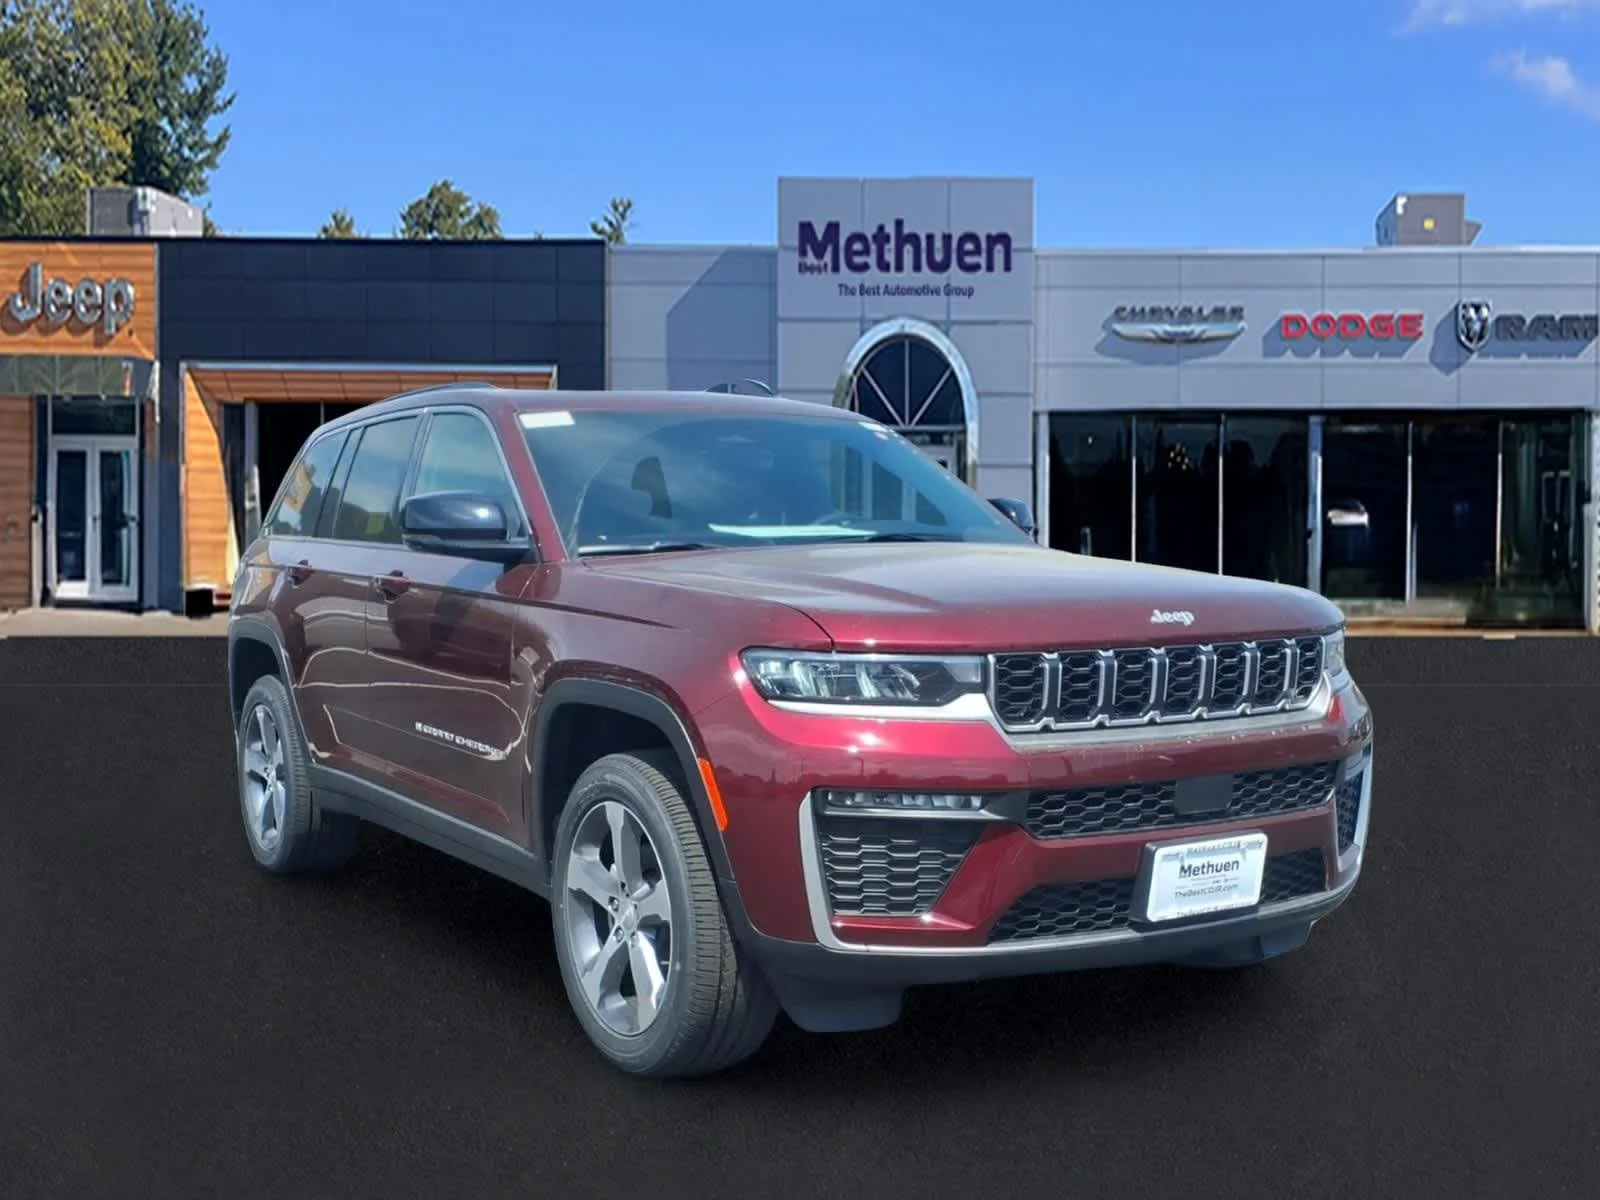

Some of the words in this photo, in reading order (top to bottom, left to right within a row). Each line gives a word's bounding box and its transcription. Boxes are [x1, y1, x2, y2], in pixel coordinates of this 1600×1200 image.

[798, 217, 1012, 274] Methuen
[9, 262, 134, 336] Jeep
[838, 283, 857, 297] The
[859, 283, 880, 297] Best
[883, 283, 941, 297] Automotive
[943, 282, 975, 300] Group
[1113, 305, 1245, 323] CHRYSLER
[1281, 312, 1425, 340] DODGE
[1495, 313, 1599, 341] RAM
[1150, 609, 1195, 626] Jeep
[1178, 859, 1240, 879] Methuen
